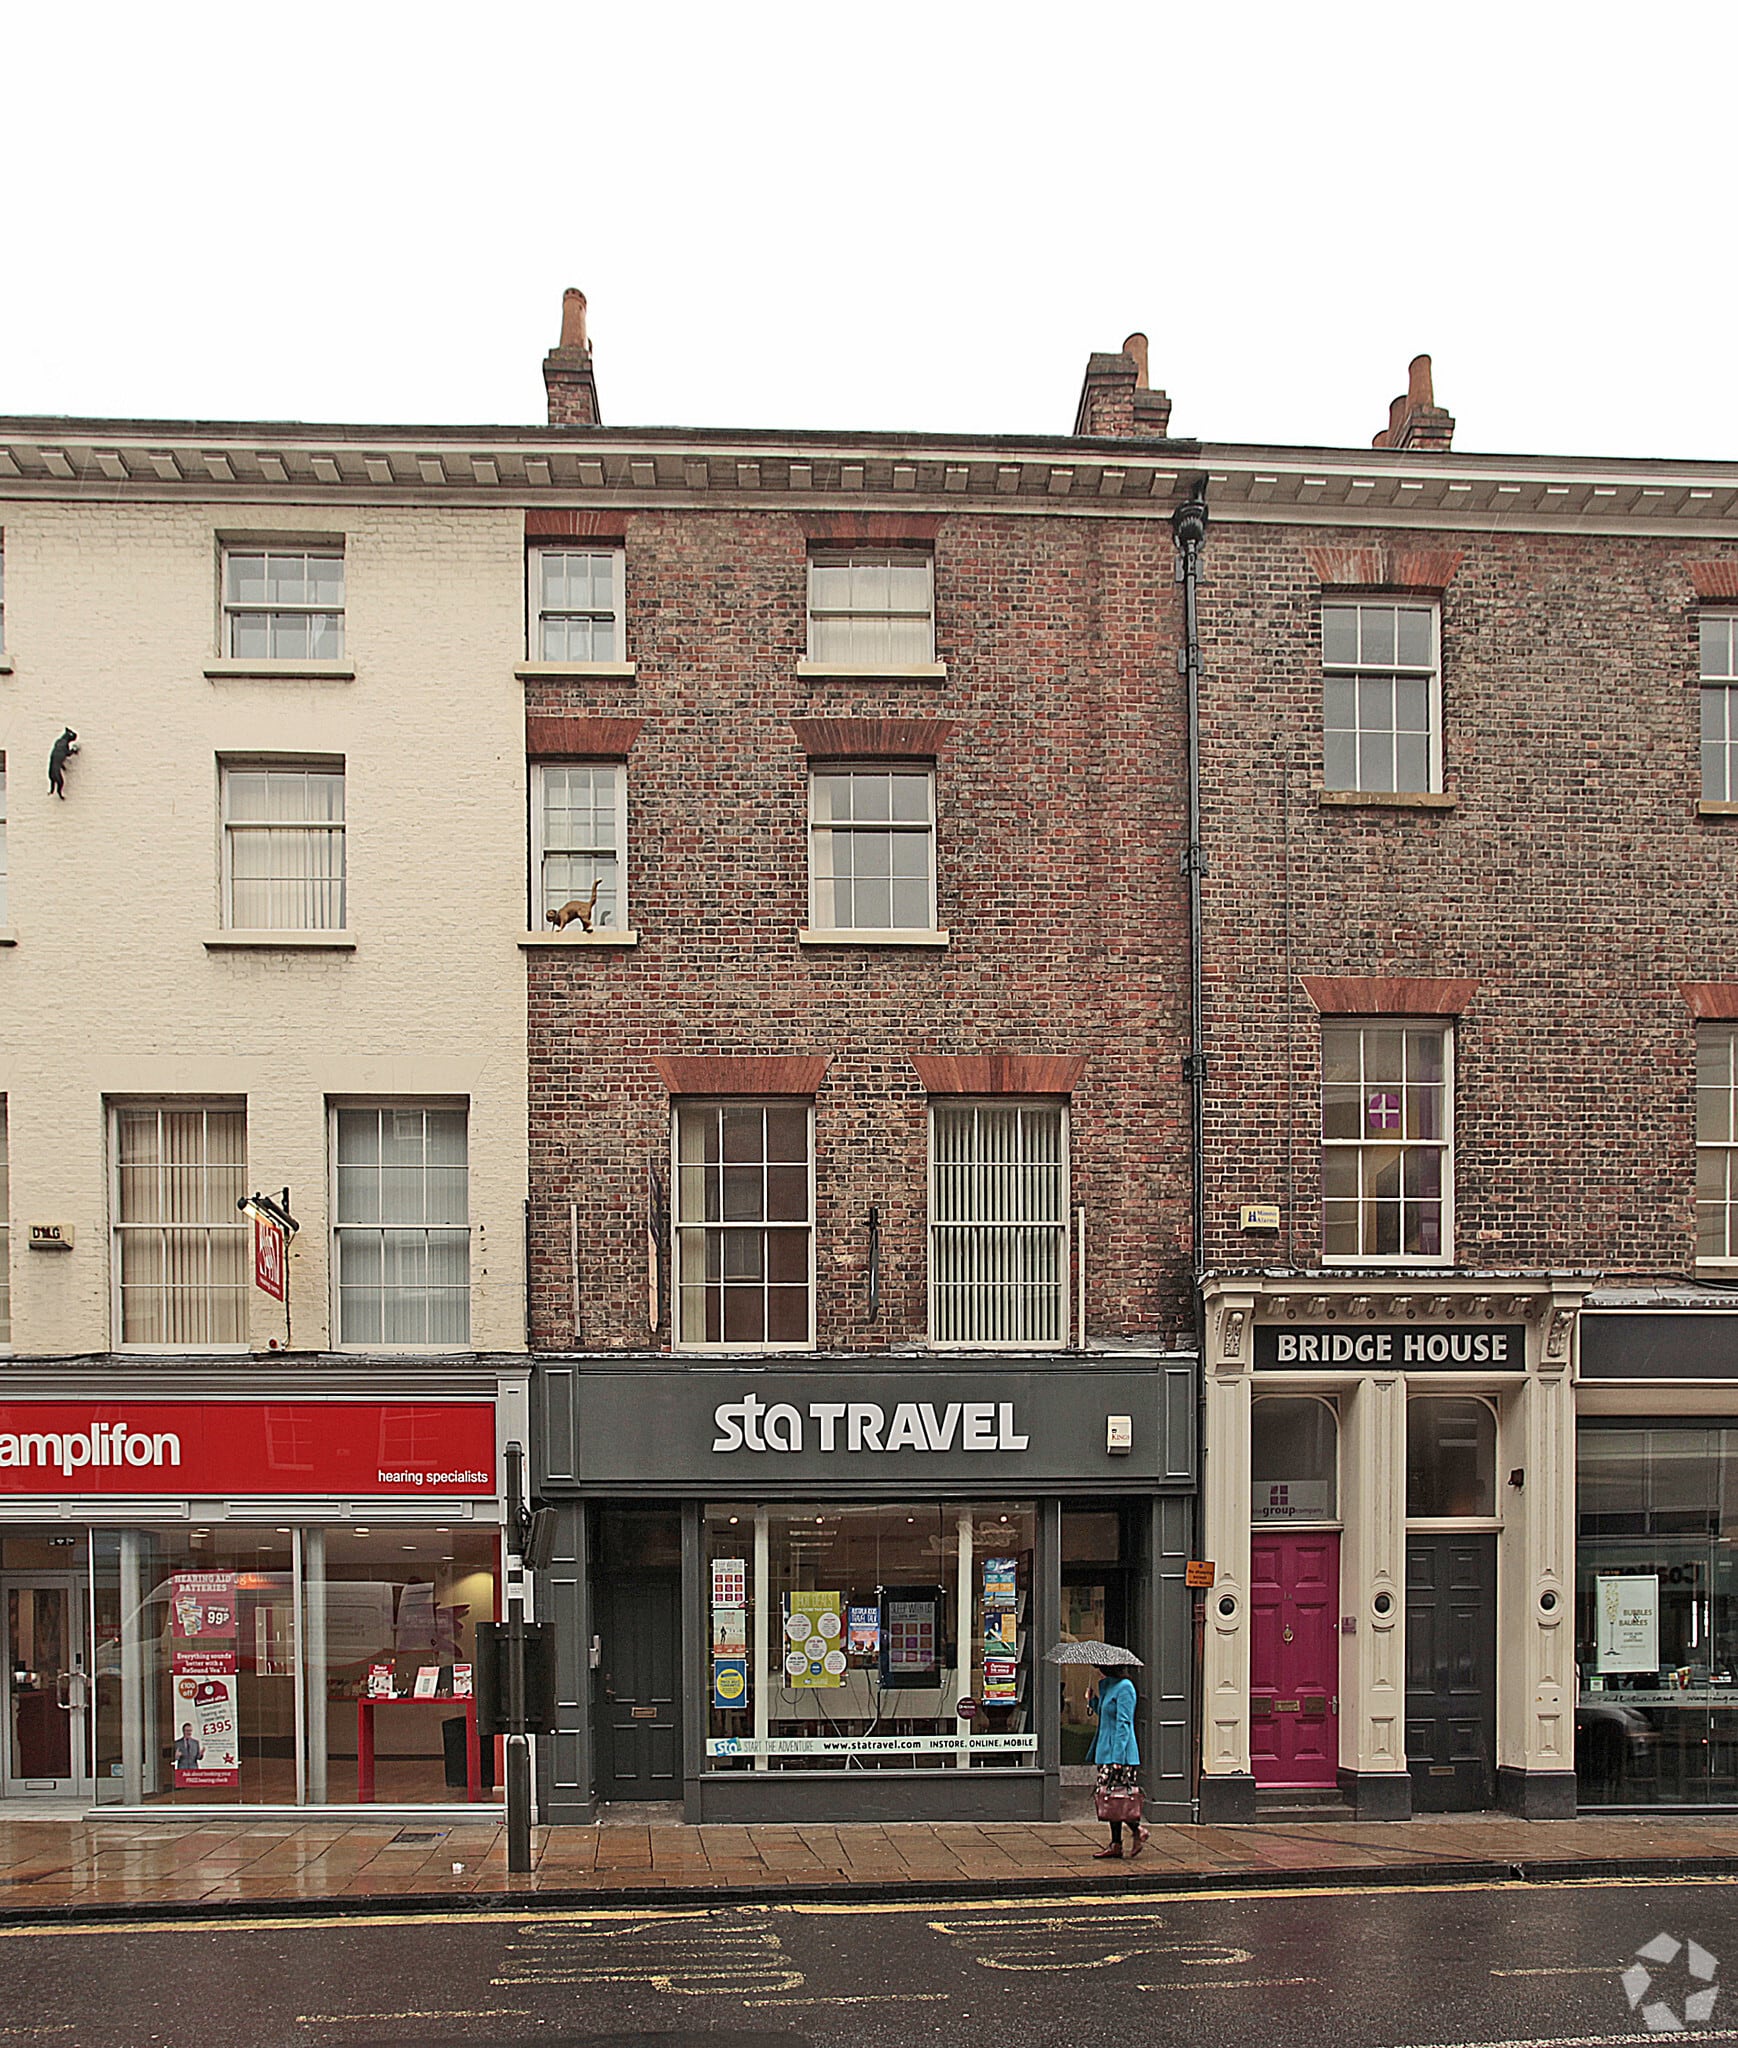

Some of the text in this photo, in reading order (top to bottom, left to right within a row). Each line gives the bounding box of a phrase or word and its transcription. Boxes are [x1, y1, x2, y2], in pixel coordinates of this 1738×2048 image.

[1278, 1334, 1508, 1362] BRIDGE HOUSE
[712, 1393, 1030, 1451] sta TRAVEL
[0, 1422, 181, 1477] amplifon
[378, 1469, 489, 1486] hearing specialists
[1262, 1506, 1296, 1518] group
[174, 1574, 215, 1583] HEARING
[215, 1573, 232, 1583] AID
[179, 1583, 228, 1592] BATTERIES
[177, 1653, 210, 1661] Everything
[203, 1720, 232, 1736] £395
[717, 1738, 1033, 1754] sta START THE ADVENTURE www.statravel.com INSTORE. ONLINE. MOBILE
[928, 1914, 1253, 1971] BUS
[490, 1917, 805, 1995] STOP
